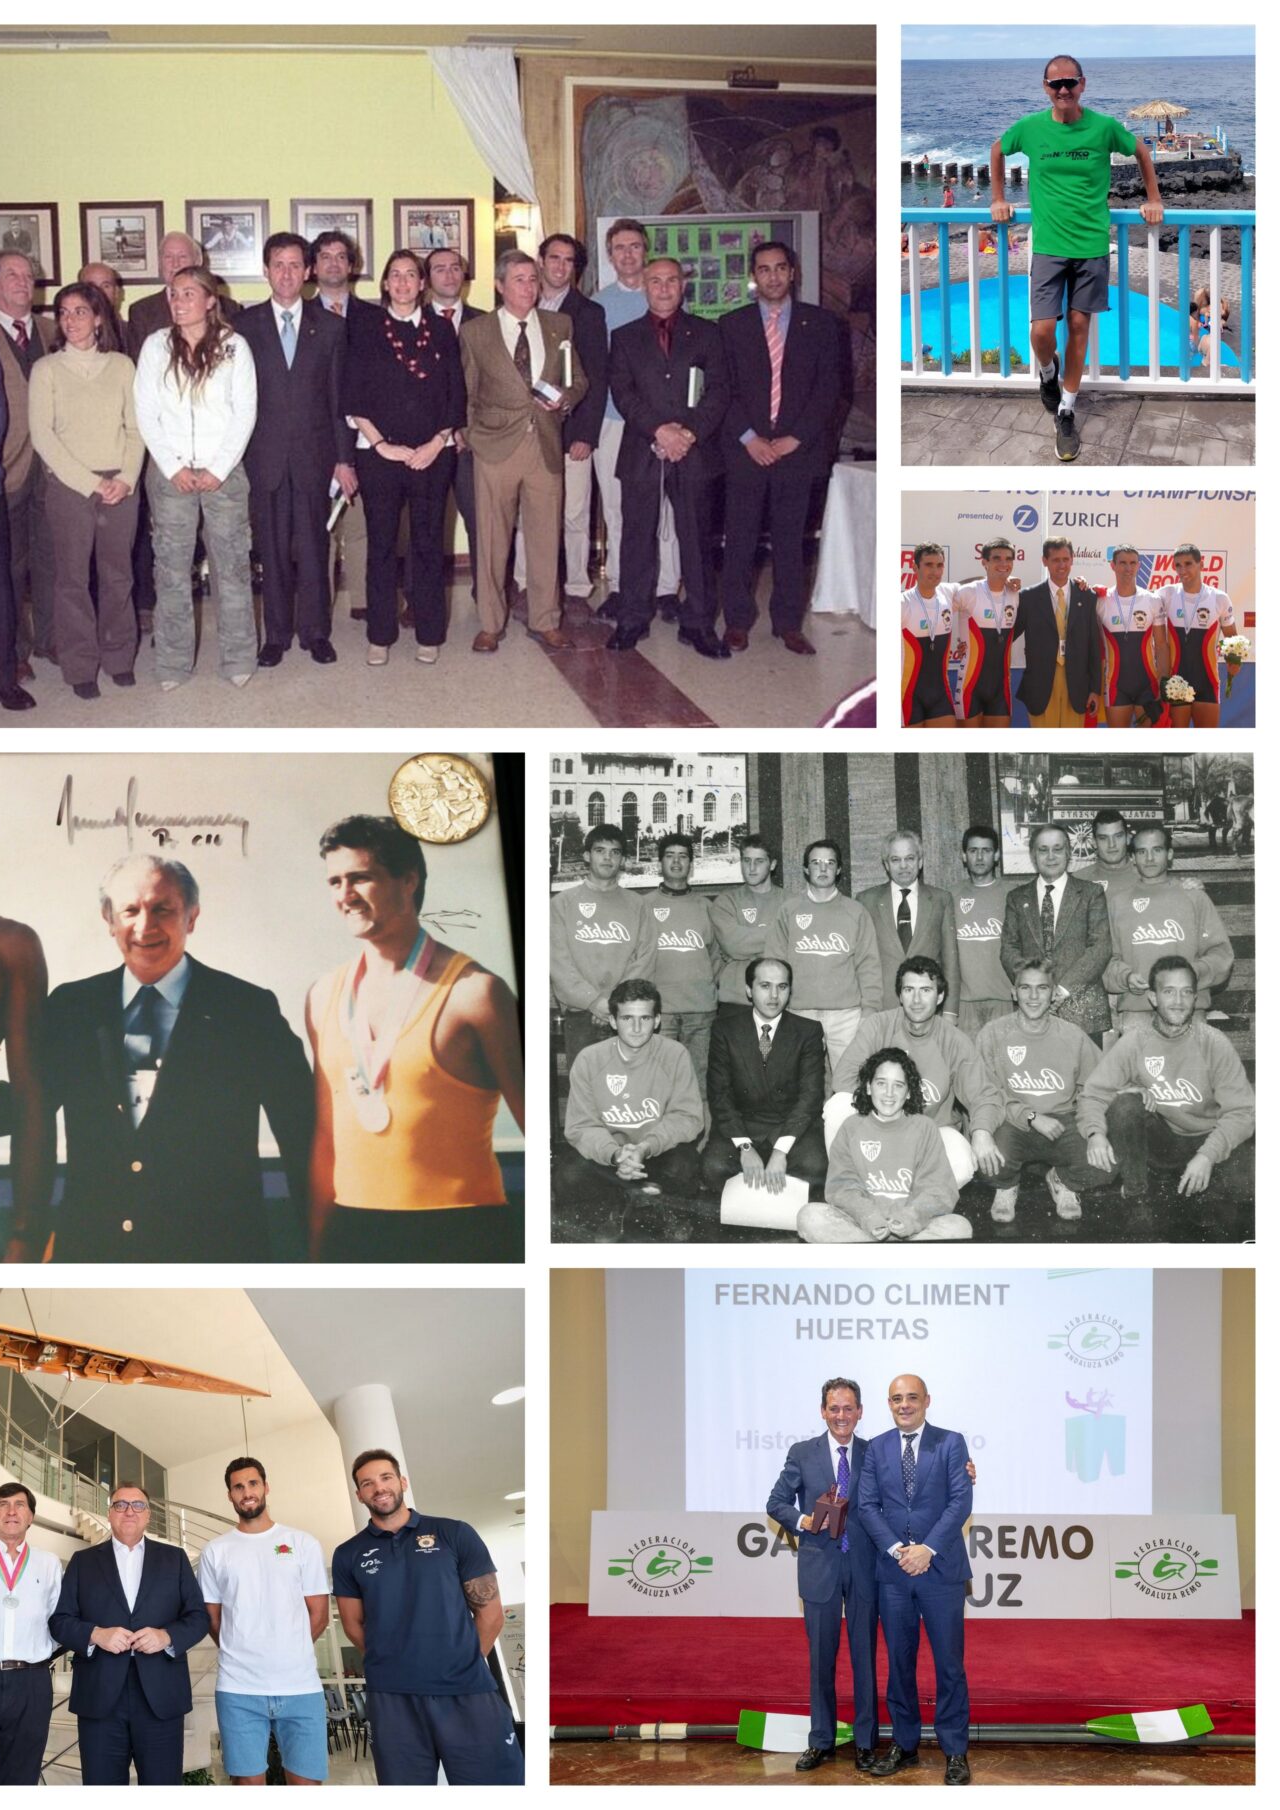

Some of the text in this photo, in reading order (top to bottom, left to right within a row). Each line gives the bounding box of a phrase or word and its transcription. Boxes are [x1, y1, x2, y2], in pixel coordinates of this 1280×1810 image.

[957, 512, 994, 520] presented
[995, 513, 1004, 521] by
[1052, 511, 1119, 528] ZURICH
[715, 1283, 1010, 1306] FERNANDO CLIMENT
[795, 1317, 930, 1341] HUERTAS
[1063, 1312, 1125, 1331] FEDERACION
[1063, 1351, 1125, 1369] ANDALUZA REMO
[627, 1535, 696, 1556] FEDERACION
[969, 1525, 1095, 1561] REMO
[1133, 1538, 1201, 1558] FEDERACION
[626, 1578, 696, 1598] ANDALUZA REMO
[1134, 1581, 1202, 1600] ANDALUZA REMO
